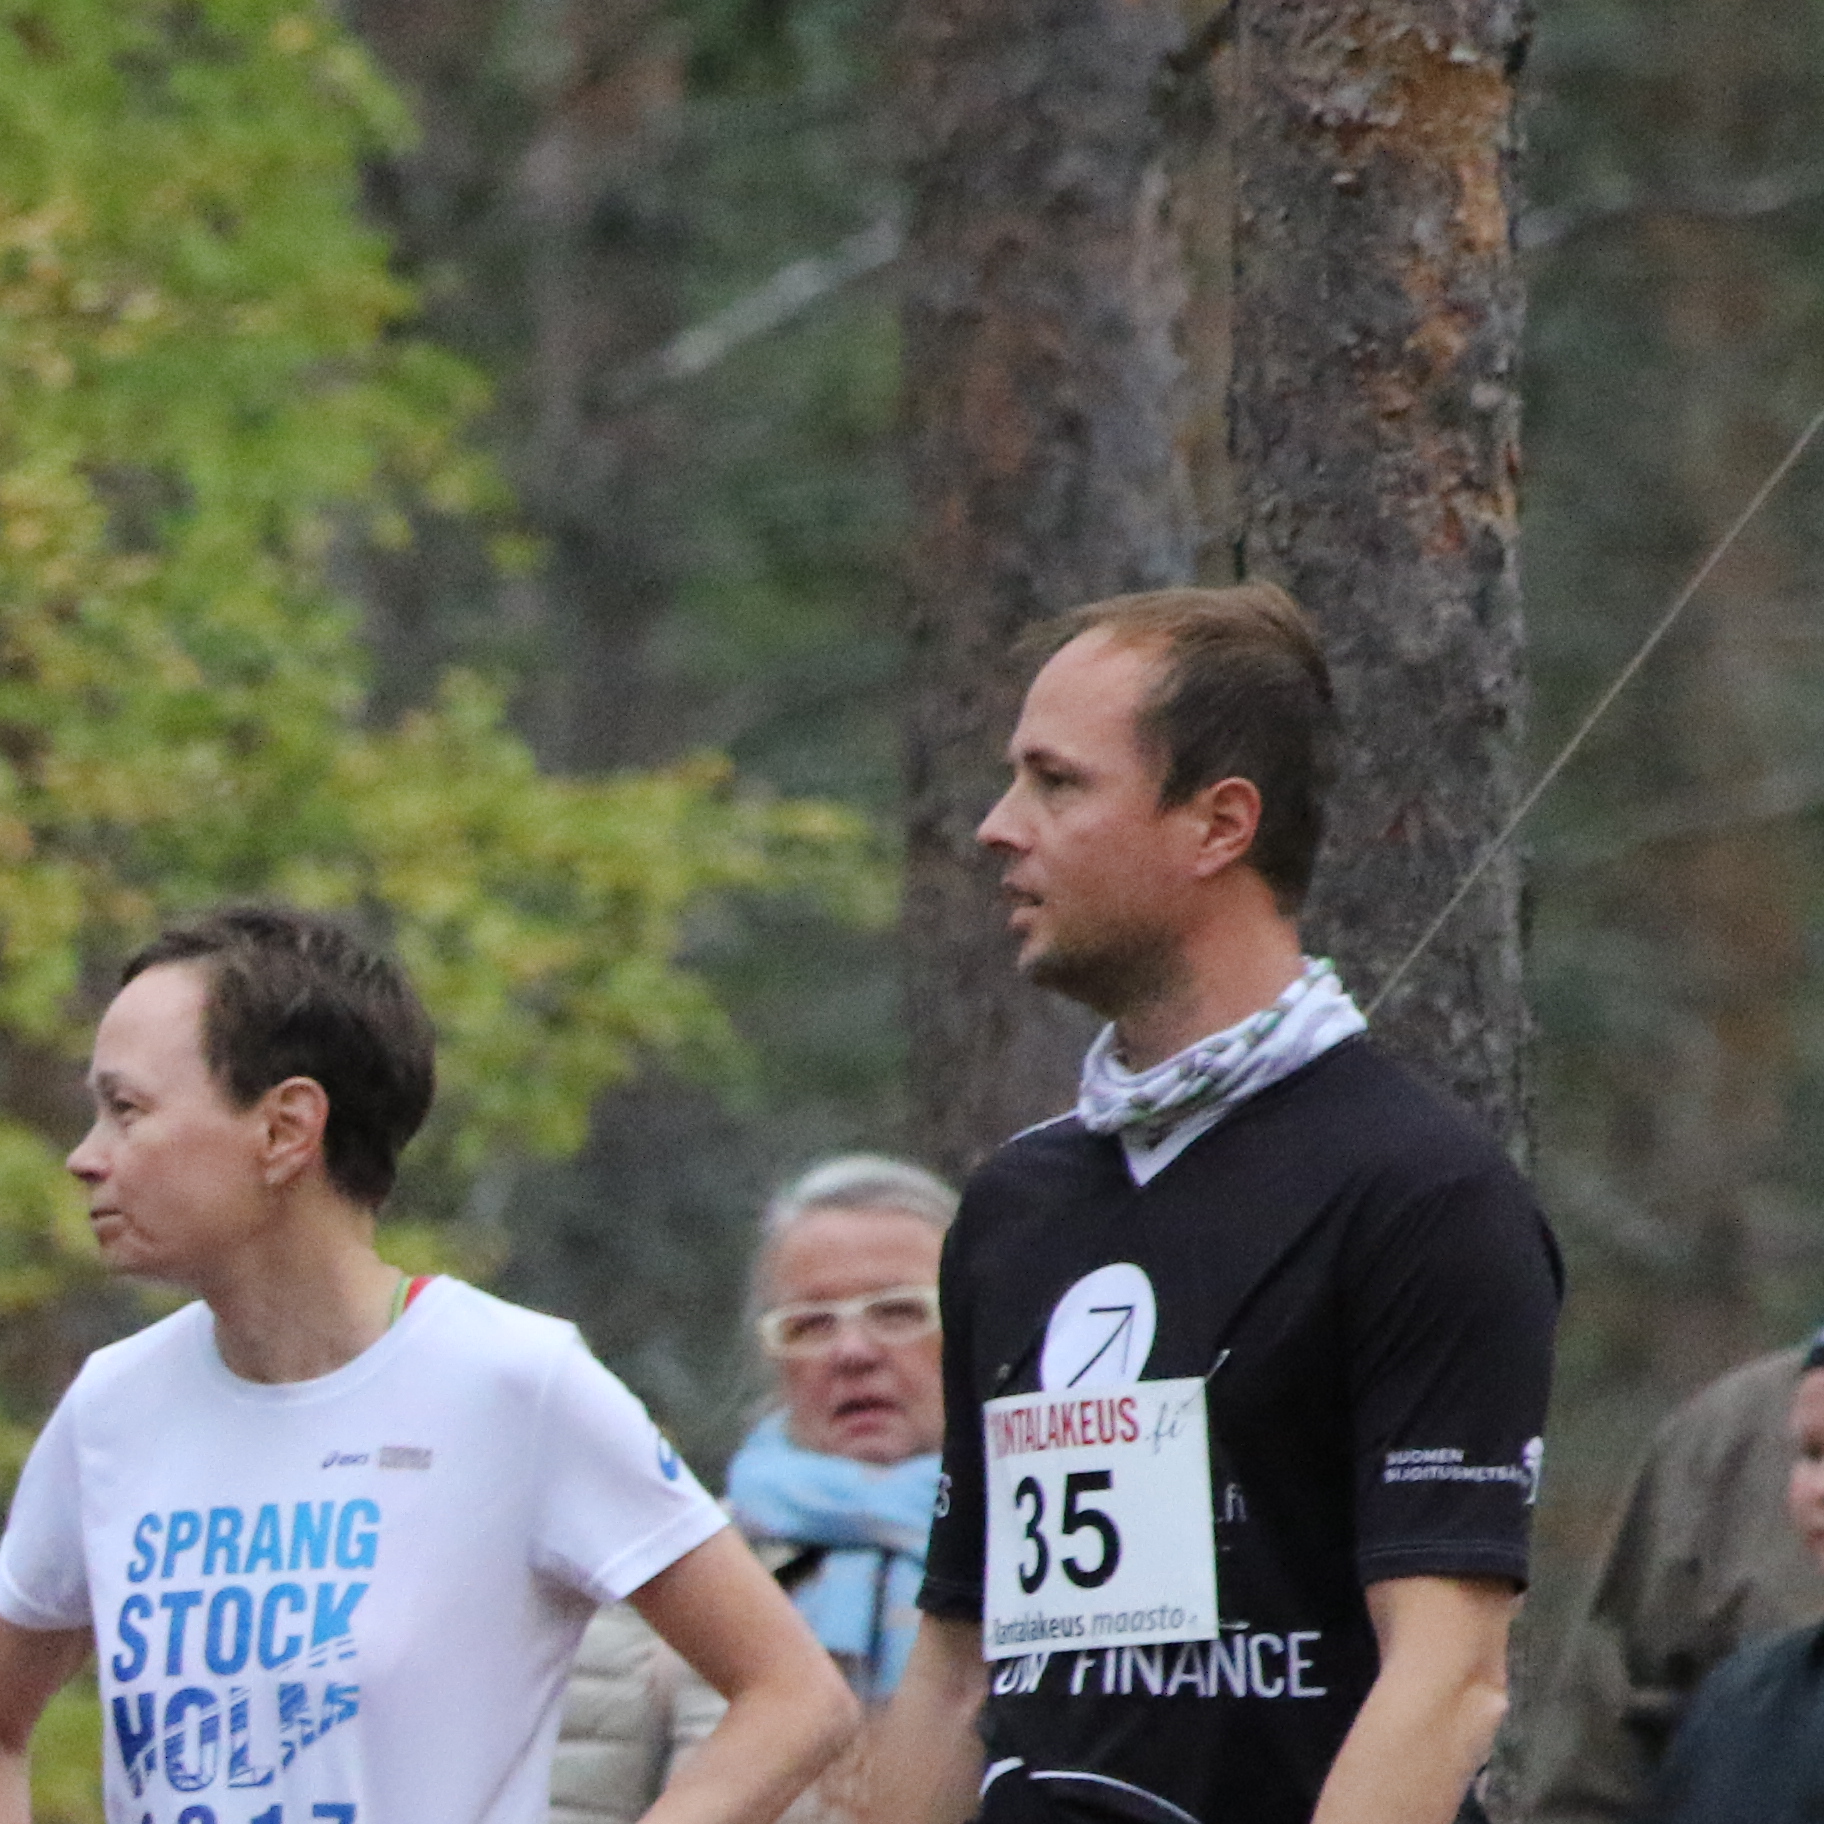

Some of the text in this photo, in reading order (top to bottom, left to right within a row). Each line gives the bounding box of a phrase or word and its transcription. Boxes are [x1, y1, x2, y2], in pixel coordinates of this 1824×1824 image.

[127, 1498, 381, 1583] SPRANG
[1015, 1469, 1120, 1594] 35
[112, 1582, 369, 1682] STOCK
[1091, 1605, 1185, 1633] maasto
[1071, 1631, 1327, 1698] FINANCE
